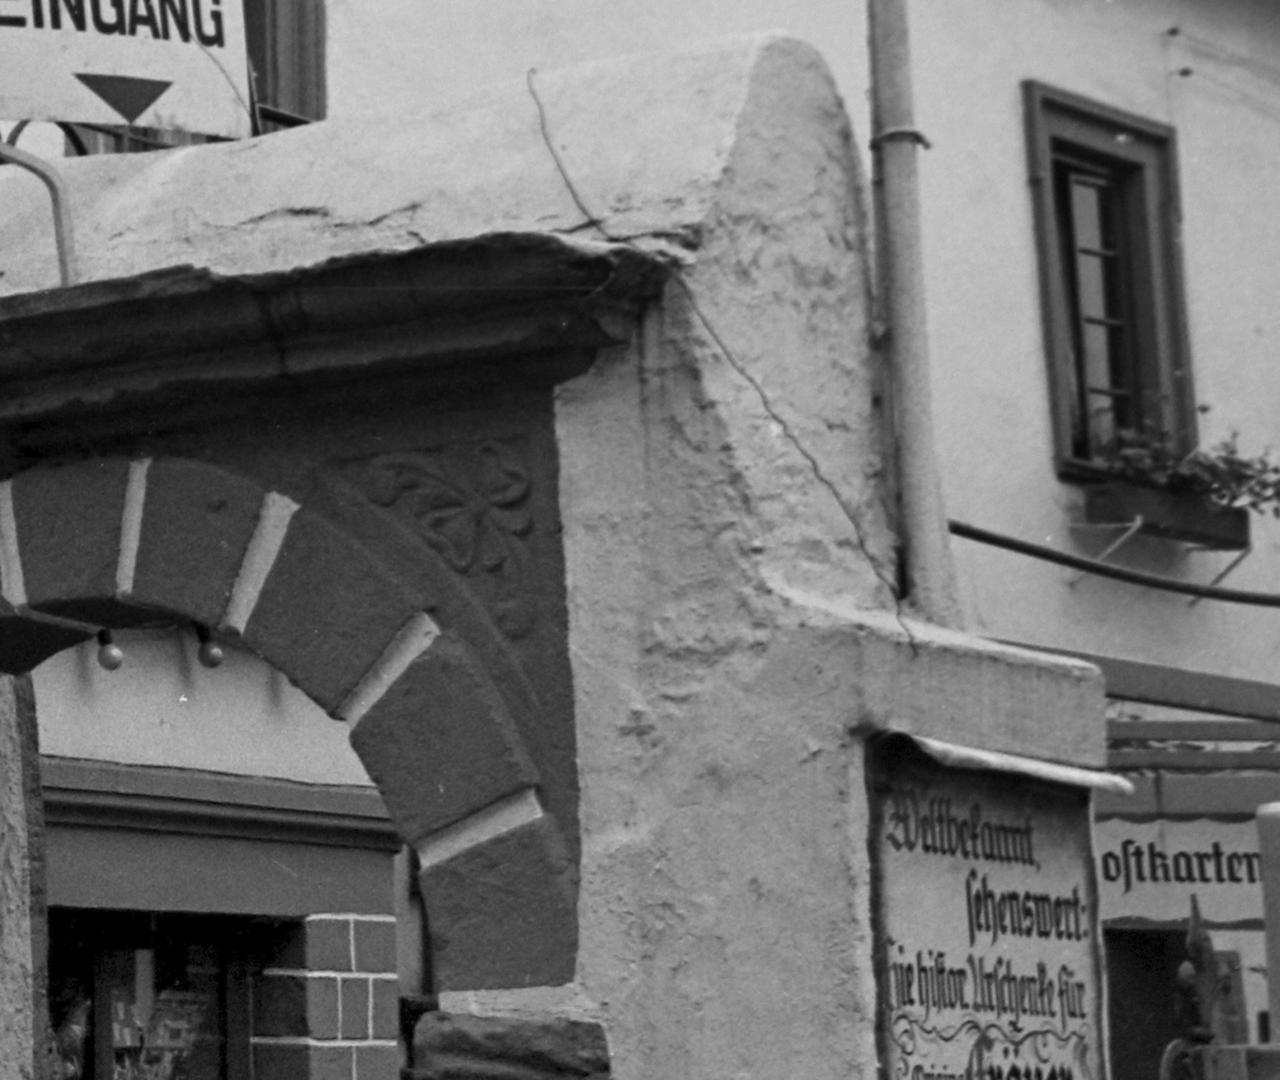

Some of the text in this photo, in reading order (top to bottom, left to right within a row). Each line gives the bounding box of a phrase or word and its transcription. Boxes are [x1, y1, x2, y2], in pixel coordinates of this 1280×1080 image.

[1102, 838, 1263, 895] ostkarten
[966, 867, 1089, 948] sehenswert:
[1057, 965, 1087, 1036] für
